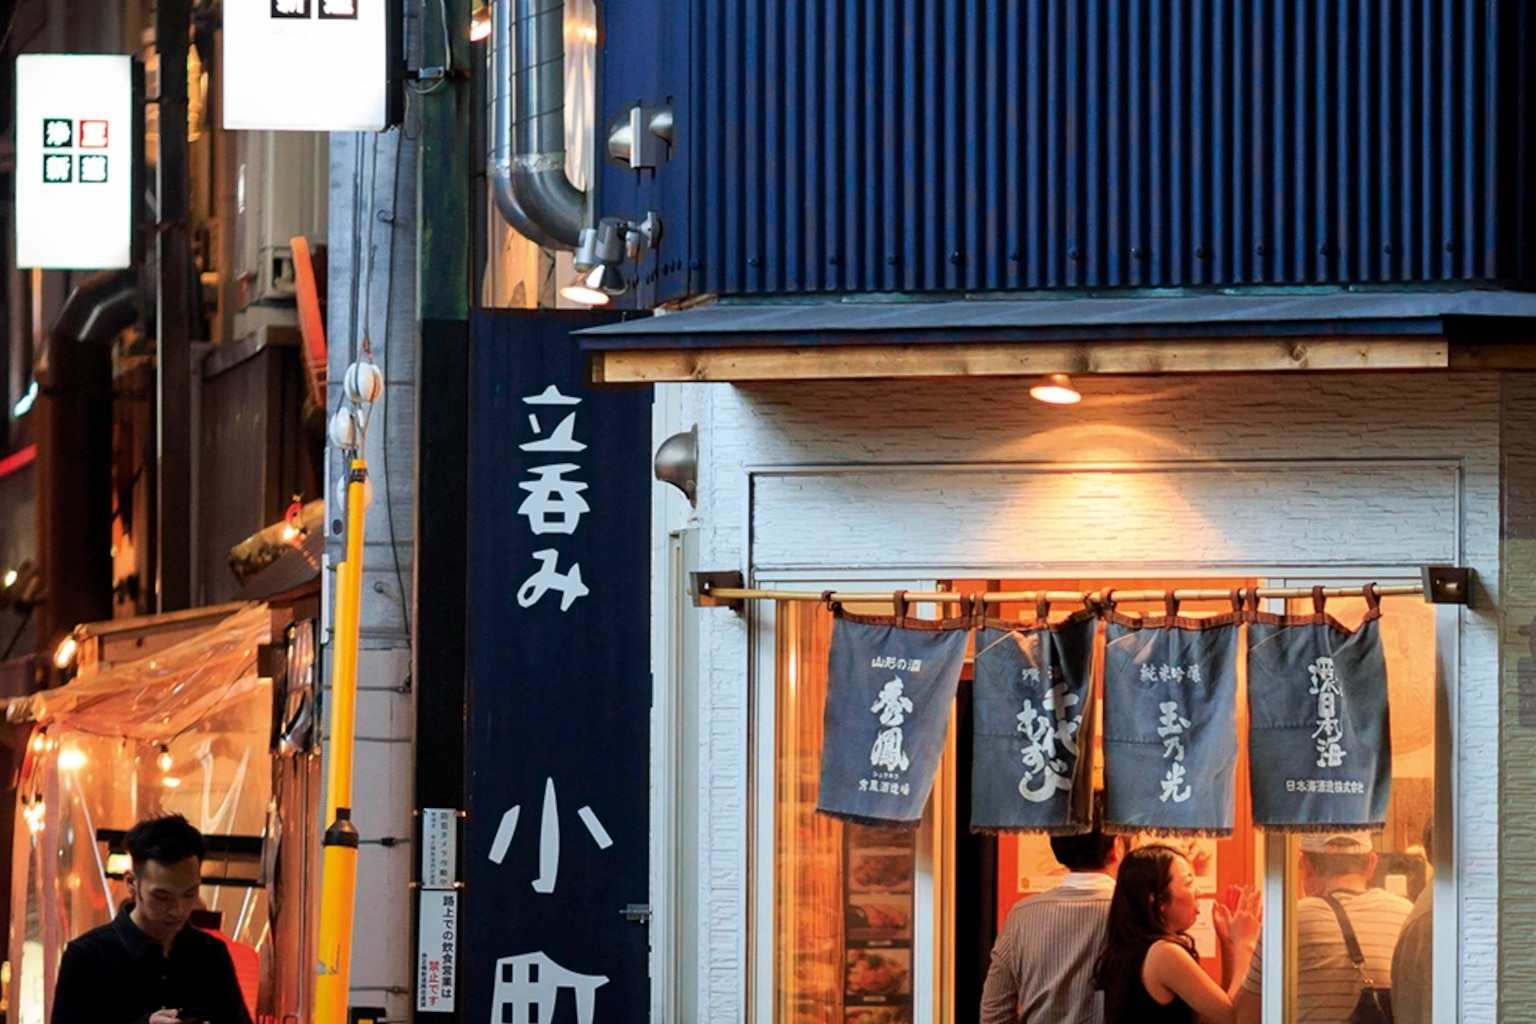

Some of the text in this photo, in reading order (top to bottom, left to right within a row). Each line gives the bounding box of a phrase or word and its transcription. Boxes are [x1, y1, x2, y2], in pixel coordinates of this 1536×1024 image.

[516, 384, 590, 612] 立呑み
[871, 656, 921, 672] 山形の酒
[870, 675, 914, 771] 秀鳳
[1157, 701, 1192, 803] 玉乃光
[428, 960, 439, 1007] 禁止です
